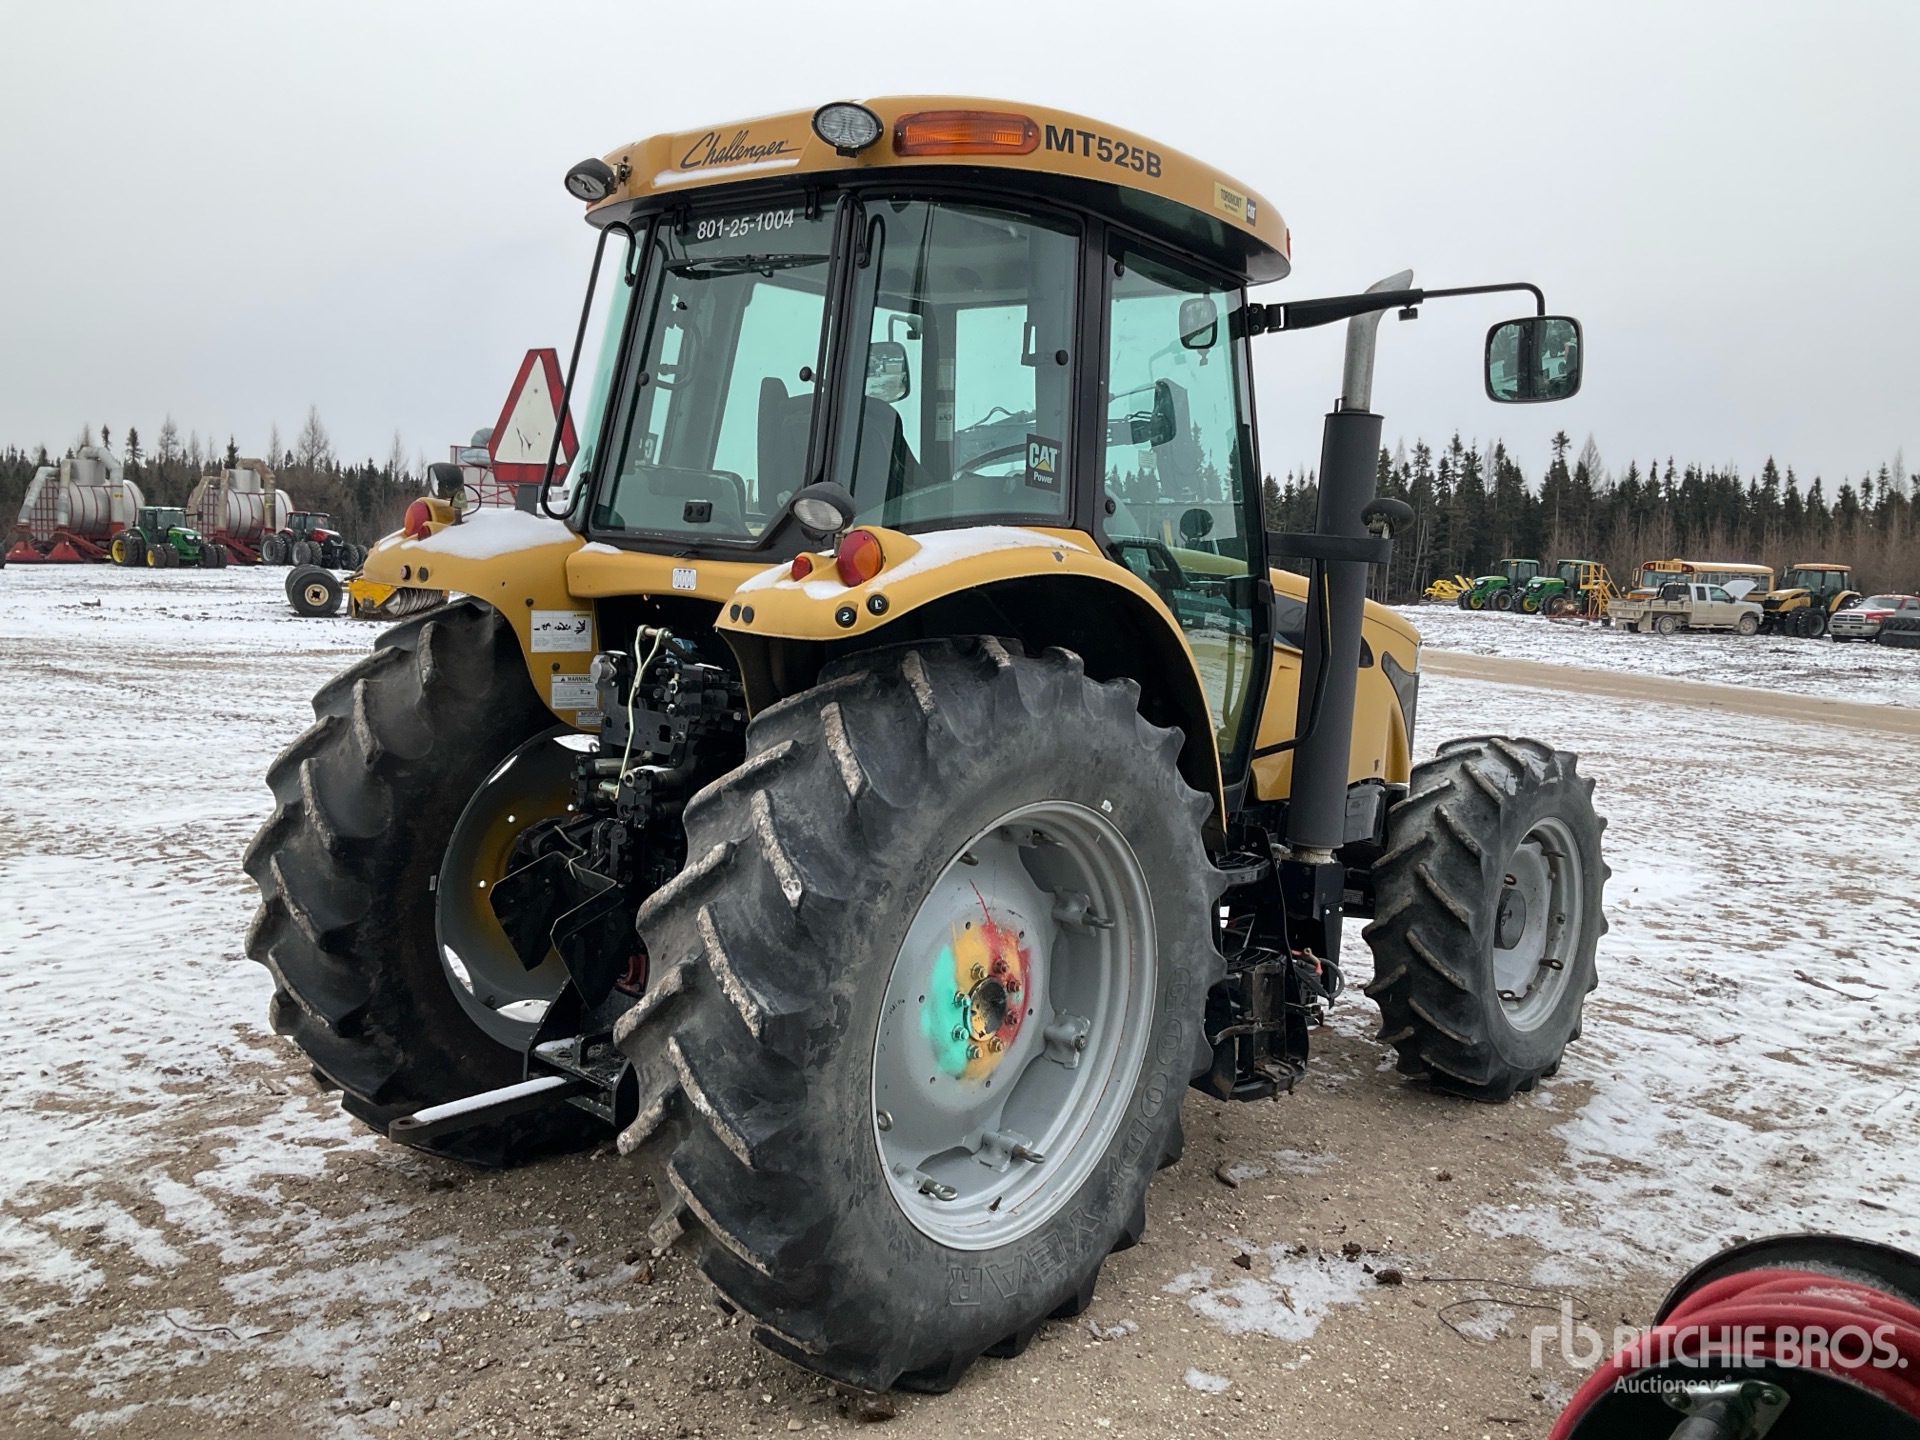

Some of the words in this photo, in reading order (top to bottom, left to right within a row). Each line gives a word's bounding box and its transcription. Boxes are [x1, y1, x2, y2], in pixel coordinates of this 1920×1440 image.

[680, 130, 802, 169] Challenger
[1045, 124, 1161, 178] MT525B
[696, 208, 795, 240] 801-25-1004
[1029, 442, 1058, 473] CAT
[1033, 471, 1053, 484] Power
